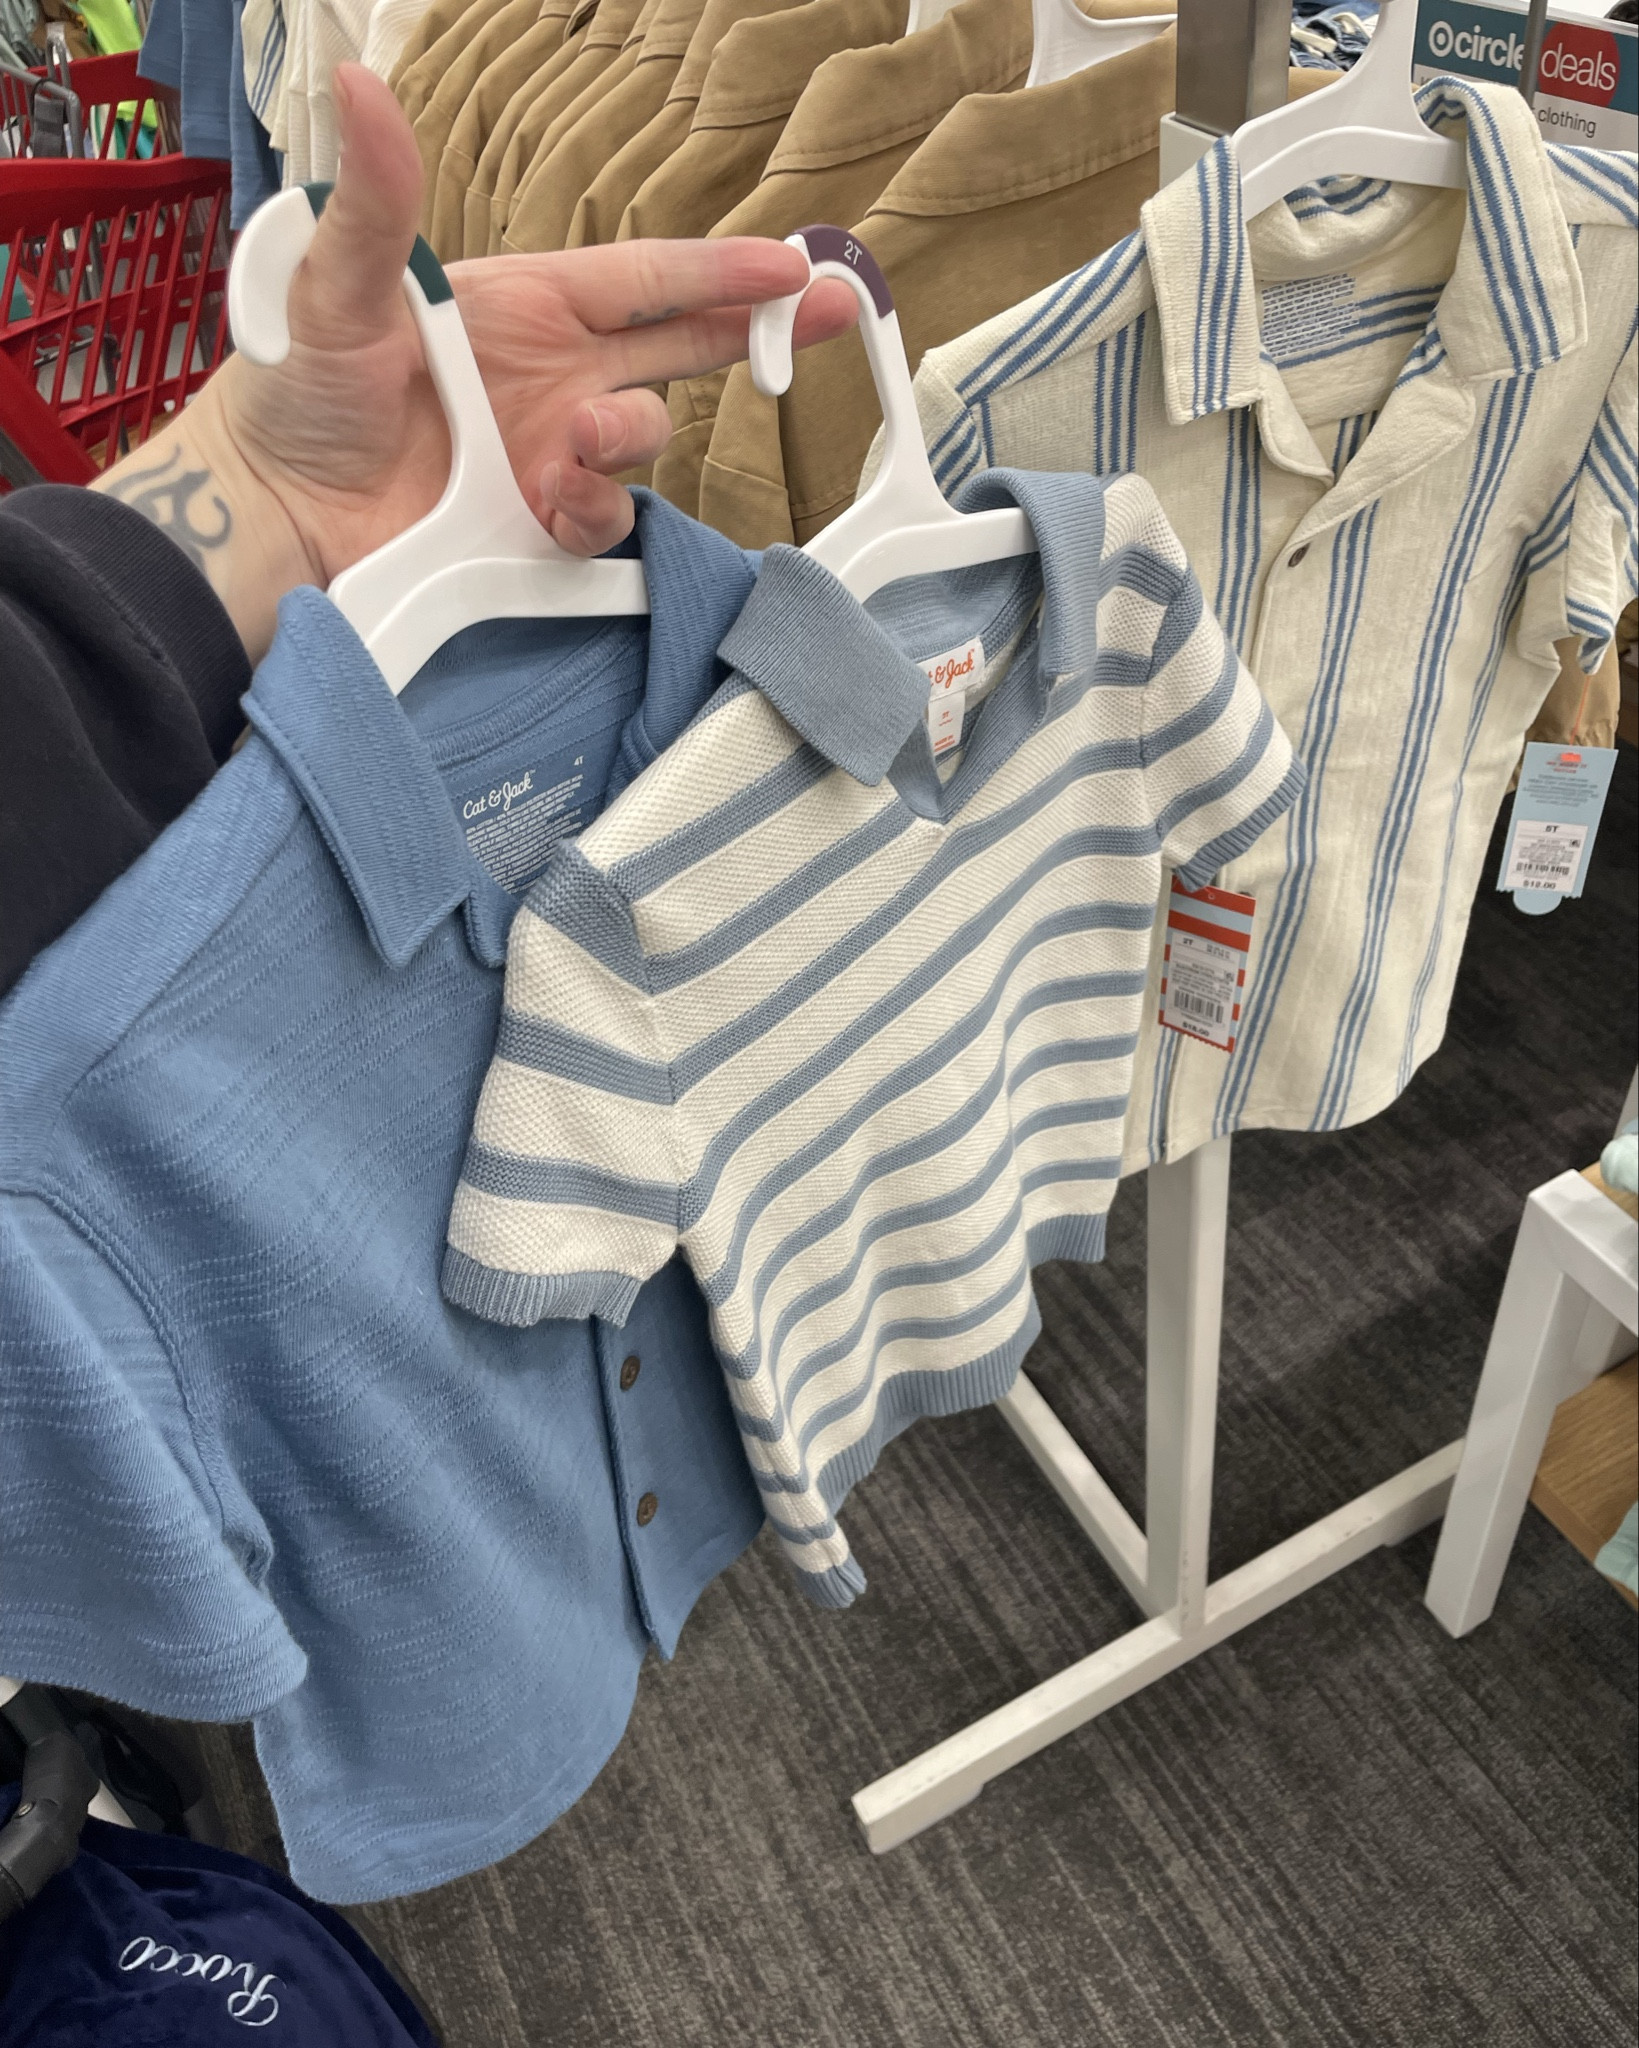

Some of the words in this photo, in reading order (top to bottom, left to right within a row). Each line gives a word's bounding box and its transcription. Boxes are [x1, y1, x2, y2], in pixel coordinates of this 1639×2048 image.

[1541, 42, 1617, 91] deals
[1538, 108, 1597, 138] clothing
[844, 240, 863, 265] 2T
[935, 665, 947, 684] &
[463, 796, 487, 819] Cat
[488, 789, 502, 807] &
[502, 772, 533, 812] Jack
[118, 1936, 287, 2026] Rocco
